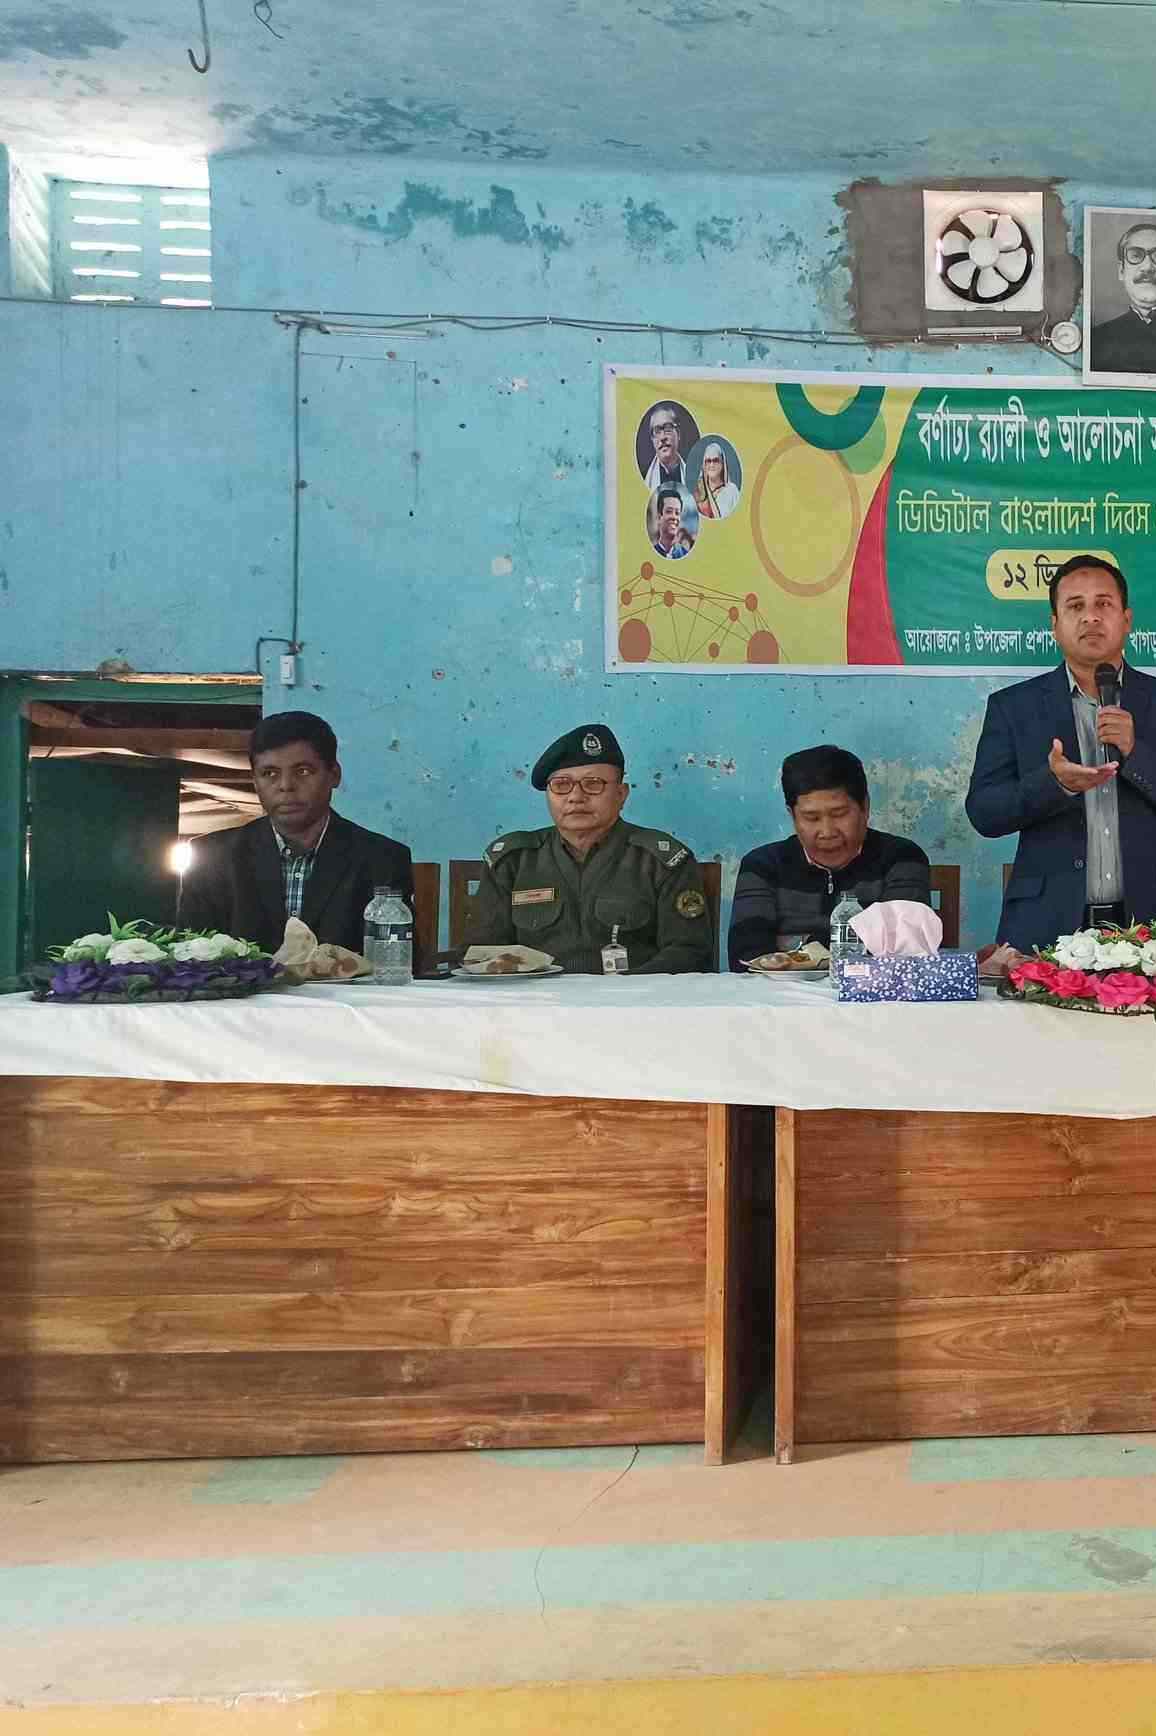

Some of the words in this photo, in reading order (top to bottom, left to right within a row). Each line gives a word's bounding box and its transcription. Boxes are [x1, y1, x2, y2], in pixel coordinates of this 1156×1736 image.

[916, 394, 972, 463] বর্ণাঢ্য
[1034, 417, 1050, 459] ও
[1056, 408, 1145, 465] আলোচনা
[896, 489, 992, 534] ডিজিটাল
[1000, 496, 1096, 535] বাংলাদেশ
[1103, 491, 1151, 535] দিবস
[1003, 562, 1029, 591] ১২
[904, 627, 960, 655] আয়োজনে
[974, 624, 1023, 656] উপজেলা
